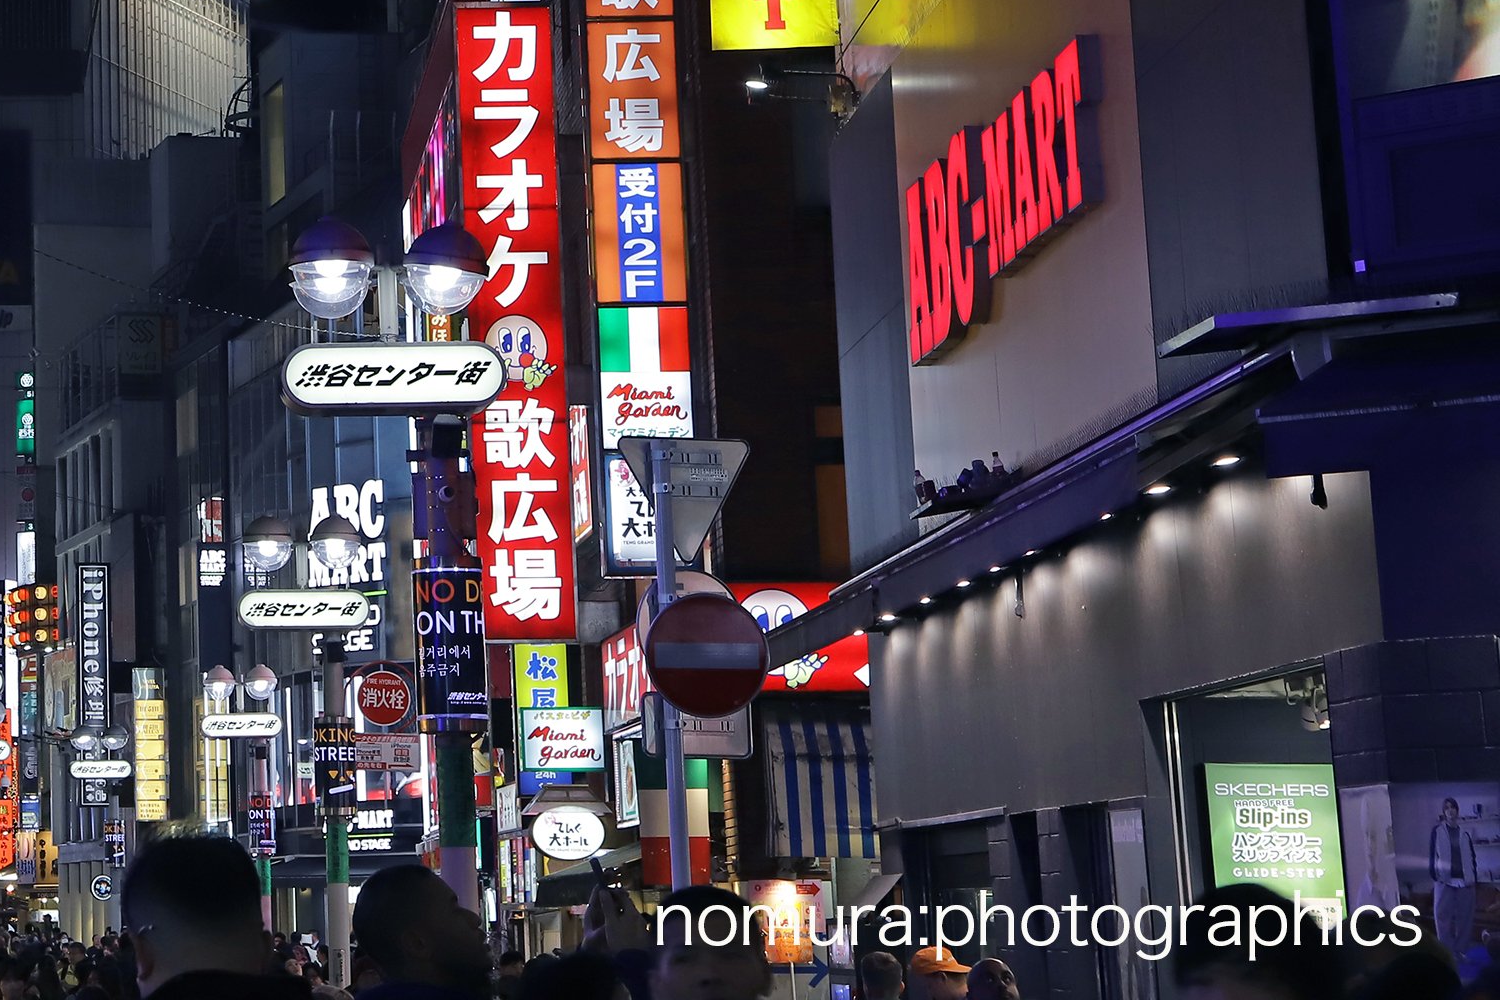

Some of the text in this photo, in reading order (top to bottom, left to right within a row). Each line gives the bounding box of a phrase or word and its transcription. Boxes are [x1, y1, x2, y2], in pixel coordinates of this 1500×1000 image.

[473, 11, 548, 307] カラオケ
[906, 38, 1082, 365] ABC-MART
[617, 167, 658, 301] 受付2F
[295, 361, 492, 390] 渋谷センター街
[607, 383, 675, 401] Miami
[308, 479, 385, 539] ABC
[482, 399, 563, 621] 歌広場
[308, 542, 387, 588] MART
[417, 579, 455, 603] NO
[246, 601, 362, 617] 渋谷センター街
[417, 611, 454, 635] ON
[378, 678, 402, 686] HYDRANT
[526, 652, 557, 707] 松屋
[605, 628, 652, 725] カラオ
[362, 687, 406, 710] 消火栓
[206, 719, 277, 730] 渋谷センター街
[528, 726, 587, 742] Miami
[1215, 783, 1329, 797] SKECHERS
[1270, 799, 1294, 807] FREE
[1238, 808, 1309, 828] Slip-ins
[1234, 834, 1320, 847] ハンズフリー
[1233, 868, 1325, 878] GLIDE-STEP
